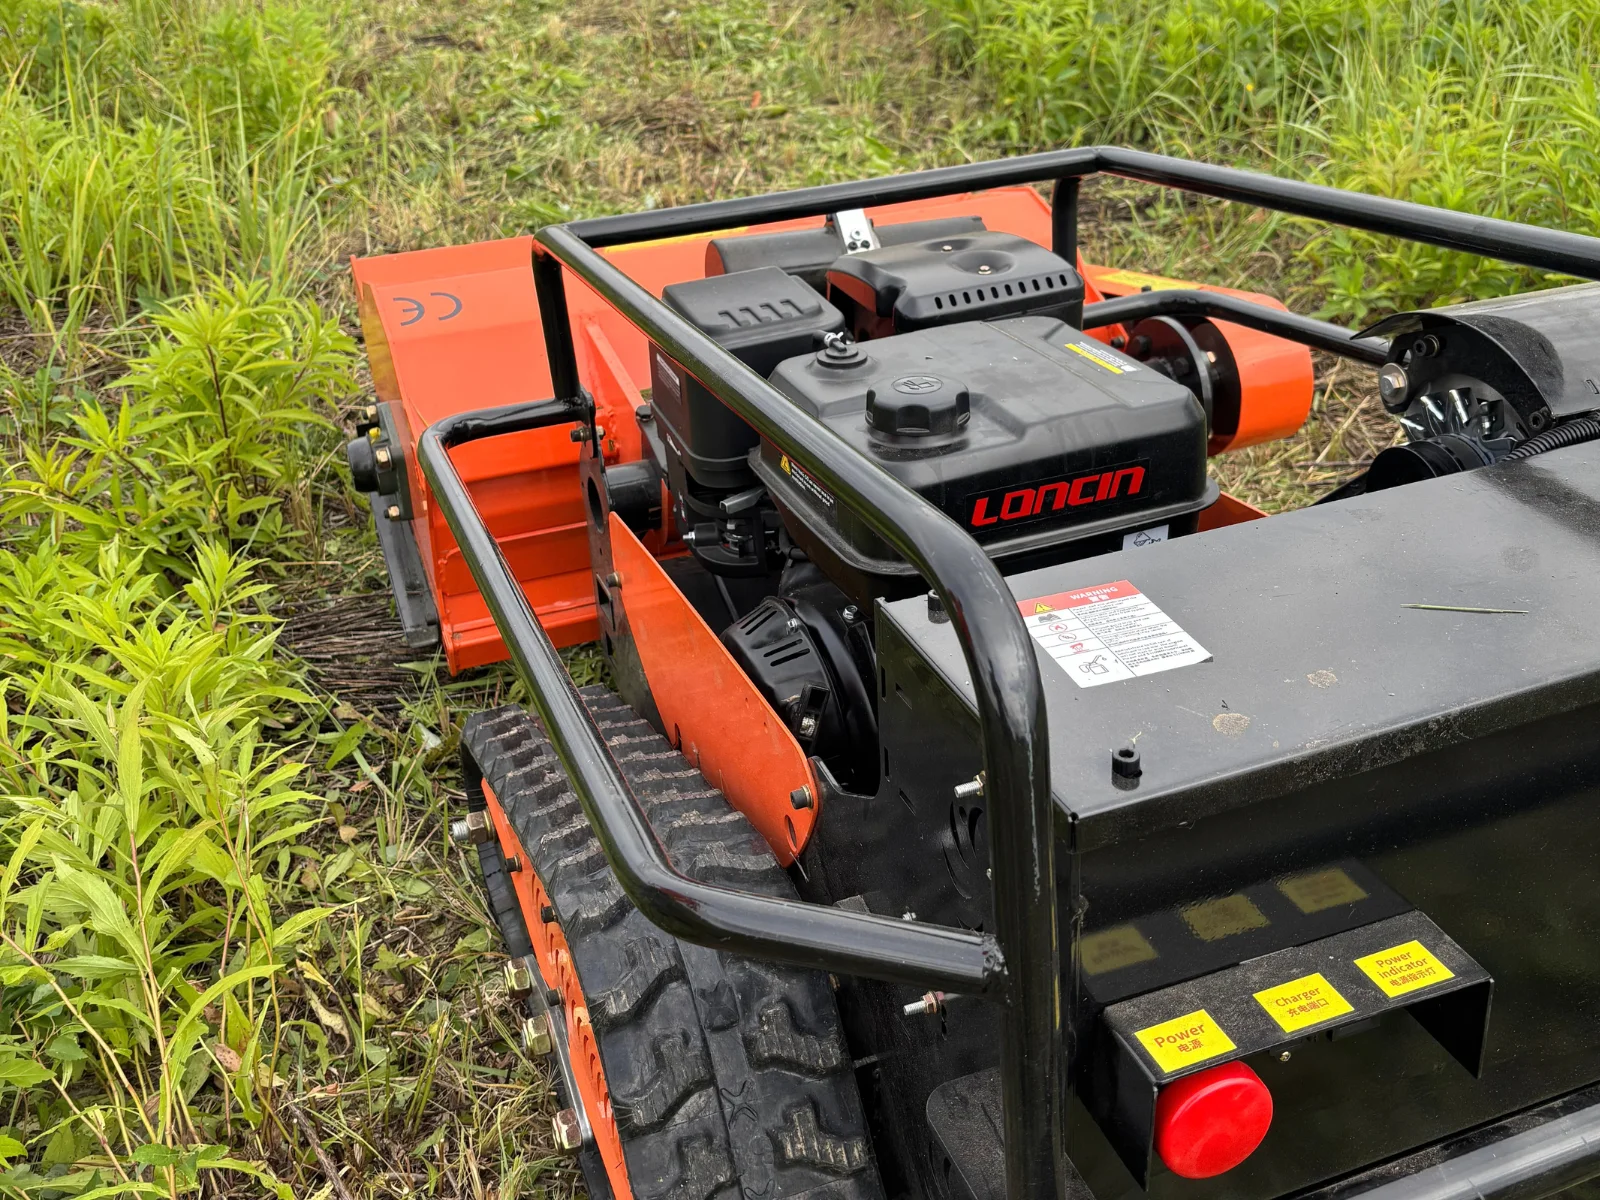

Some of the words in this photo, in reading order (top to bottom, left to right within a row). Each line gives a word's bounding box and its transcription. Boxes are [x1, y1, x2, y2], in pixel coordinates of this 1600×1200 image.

[1069, 586, 1119, 600] WARNING
[1376, 952, 1412, 968] Power
[1377, 957, 1429, 979] indicator
[1389, 966, 1437, 987] 电源指示灯
[1275, 987, 1321, 1007] Charger
[1287, 998, 1330, 1018] 充电端口
[1154, 1024, 1206, 1048] Power
[1177, 1038, 1204, 1053] 电源
